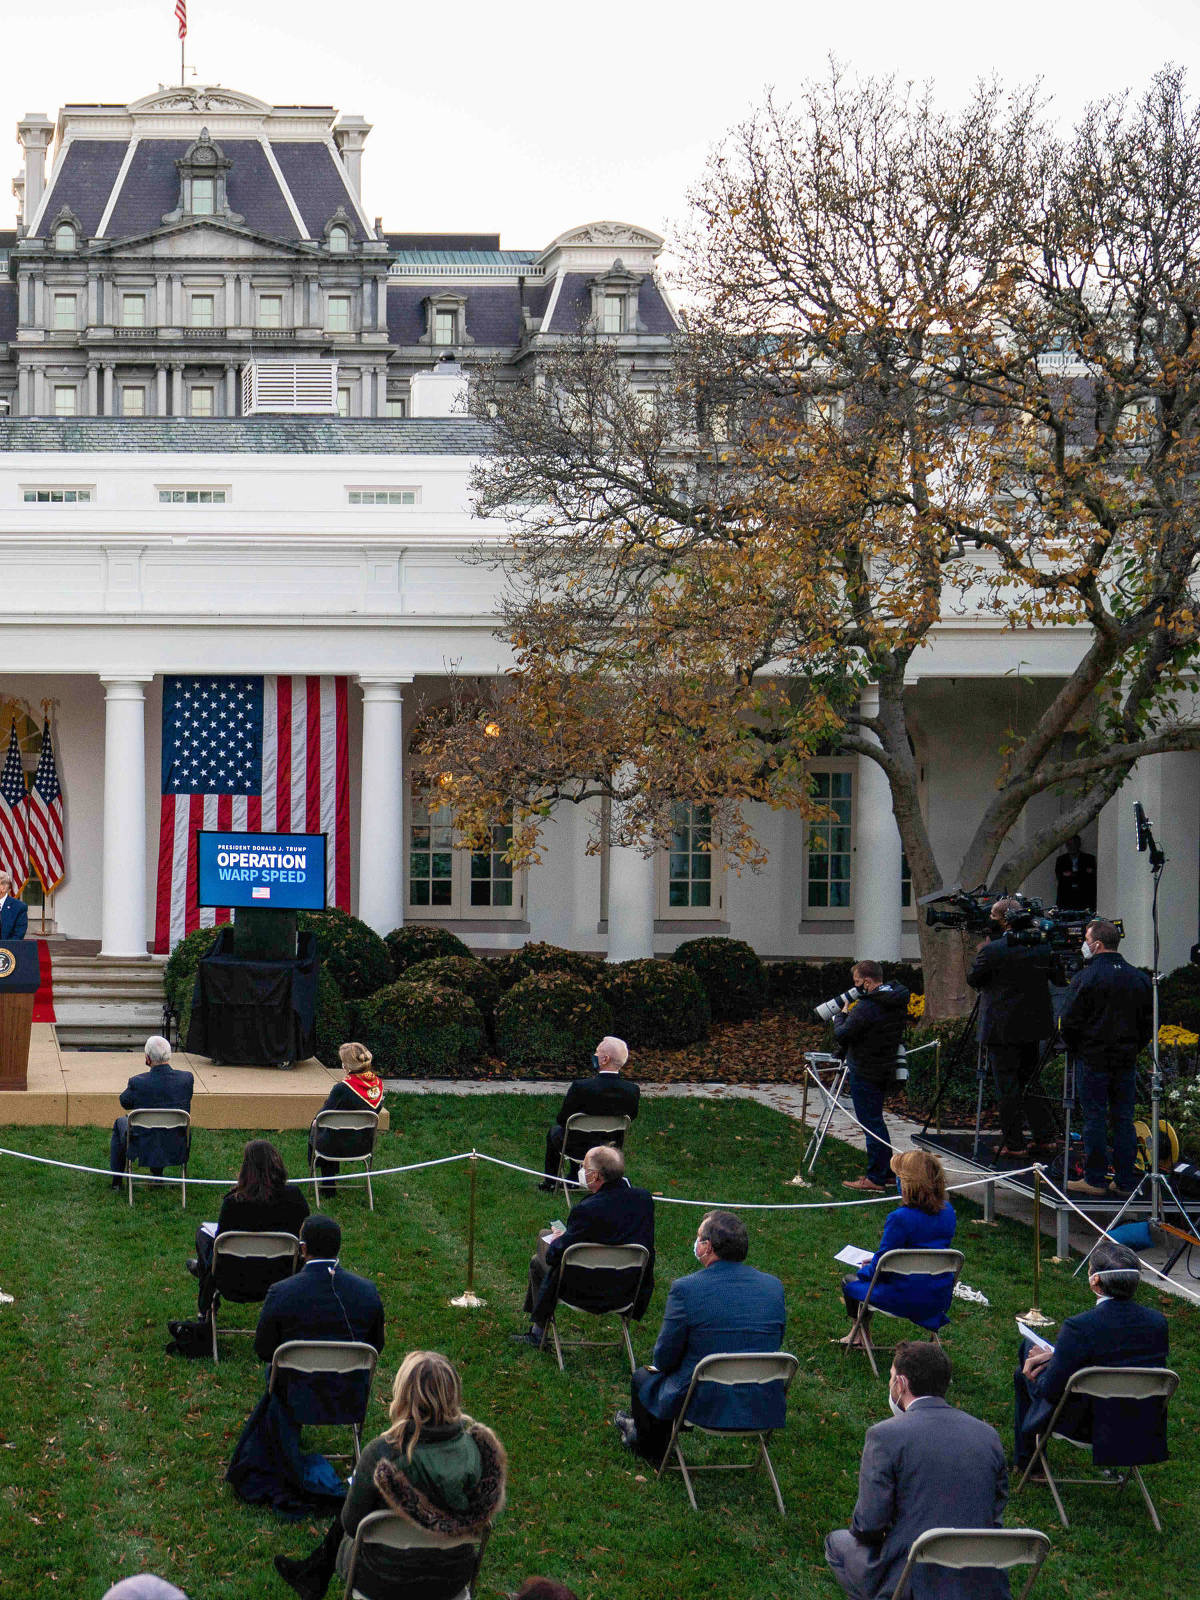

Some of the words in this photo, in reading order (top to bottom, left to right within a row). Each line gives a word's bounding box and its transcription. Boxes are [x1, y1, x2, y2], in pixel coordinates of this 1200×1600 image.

[217, 852, 306, 869] OPERATION
[218, 868, 258, 881] WARP
[262, 870, 306, 882] SPEED
